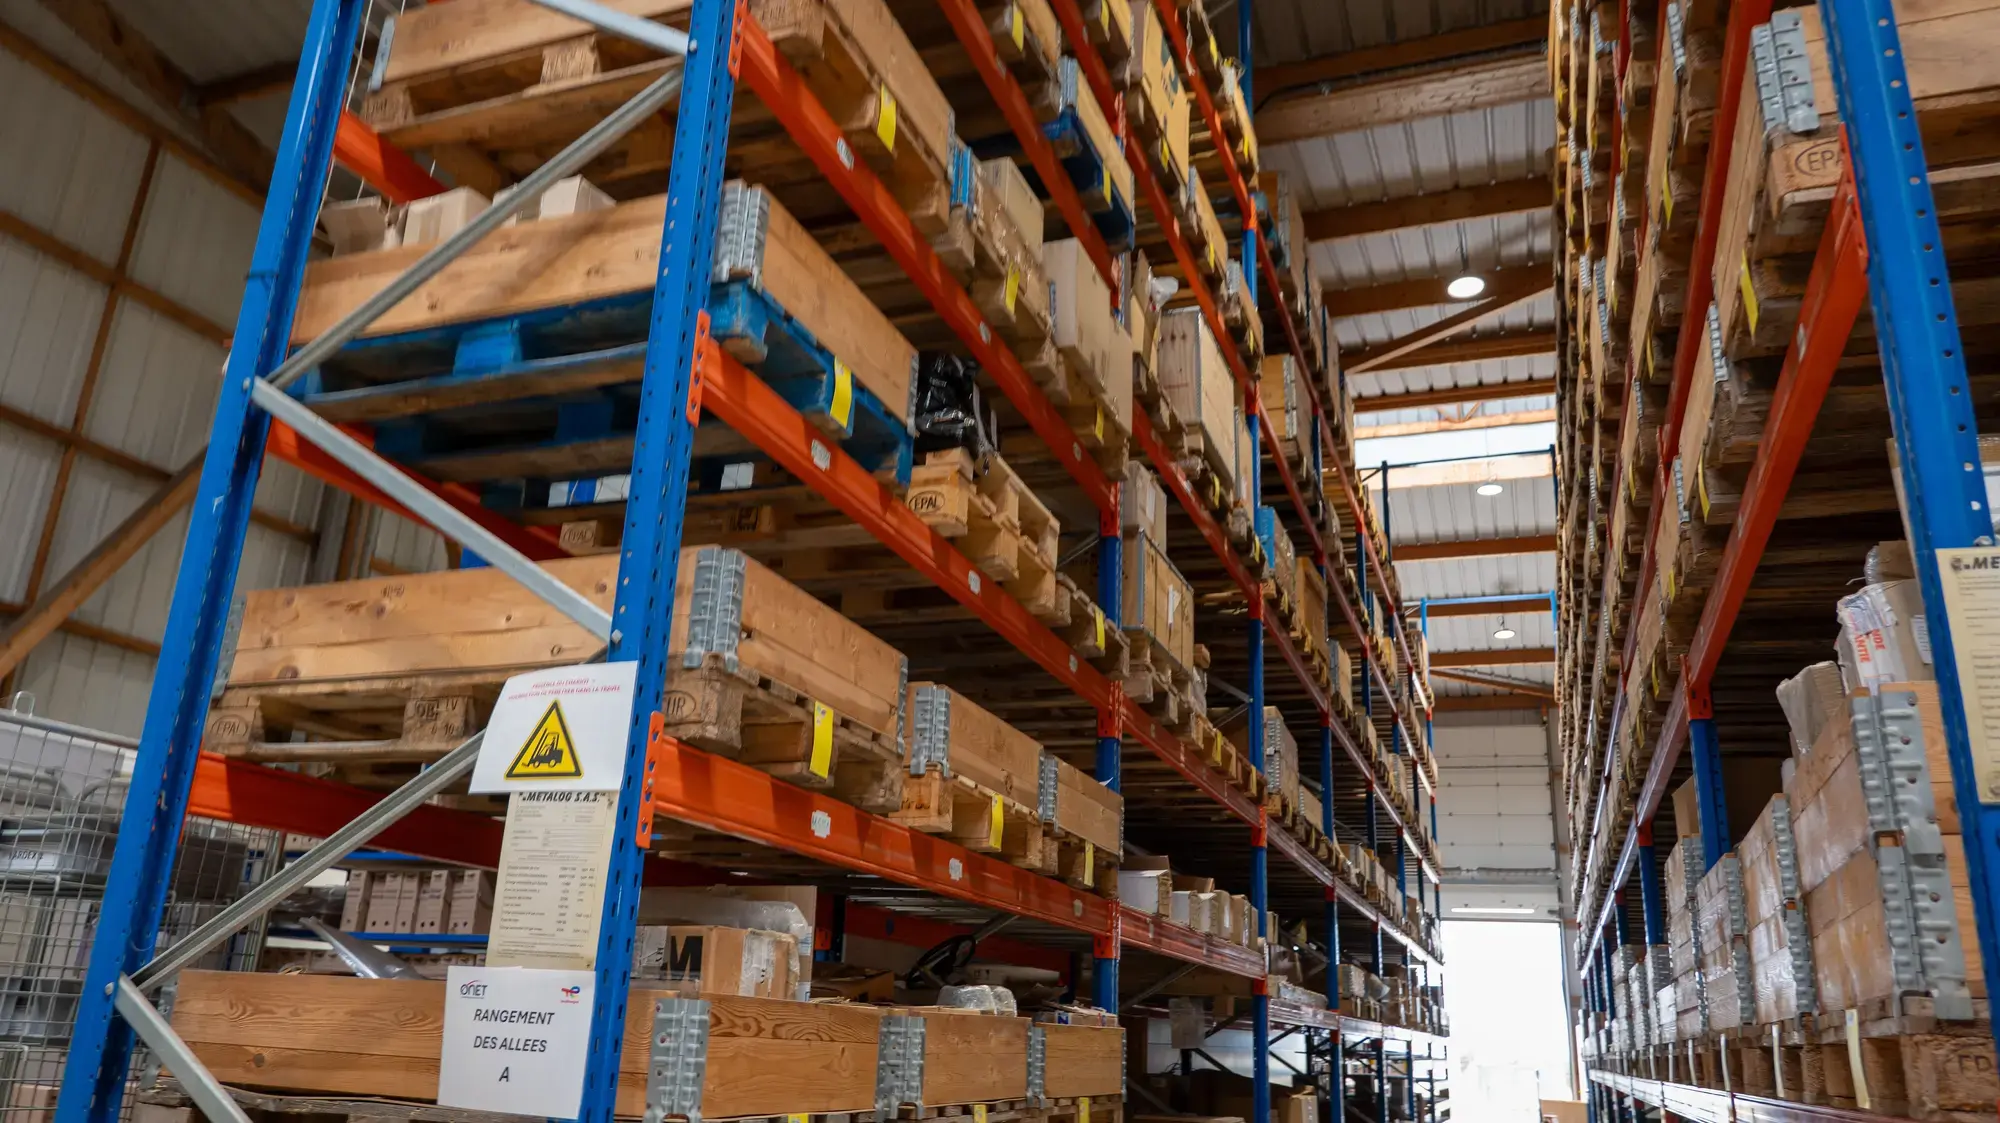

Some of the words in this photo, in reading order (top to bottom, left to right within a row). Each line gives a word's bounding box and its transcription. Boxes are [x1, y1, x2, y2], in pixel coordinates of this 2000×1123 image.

[1854, 634, 1871, 663] ANTIE
[473, 1008, 555, 1026] RANGEMENT
[473, 1035, 498, 1050] DES
[499, 1038, 548, 1053] ALLEES
[498, 1066, 510, 1082] A
